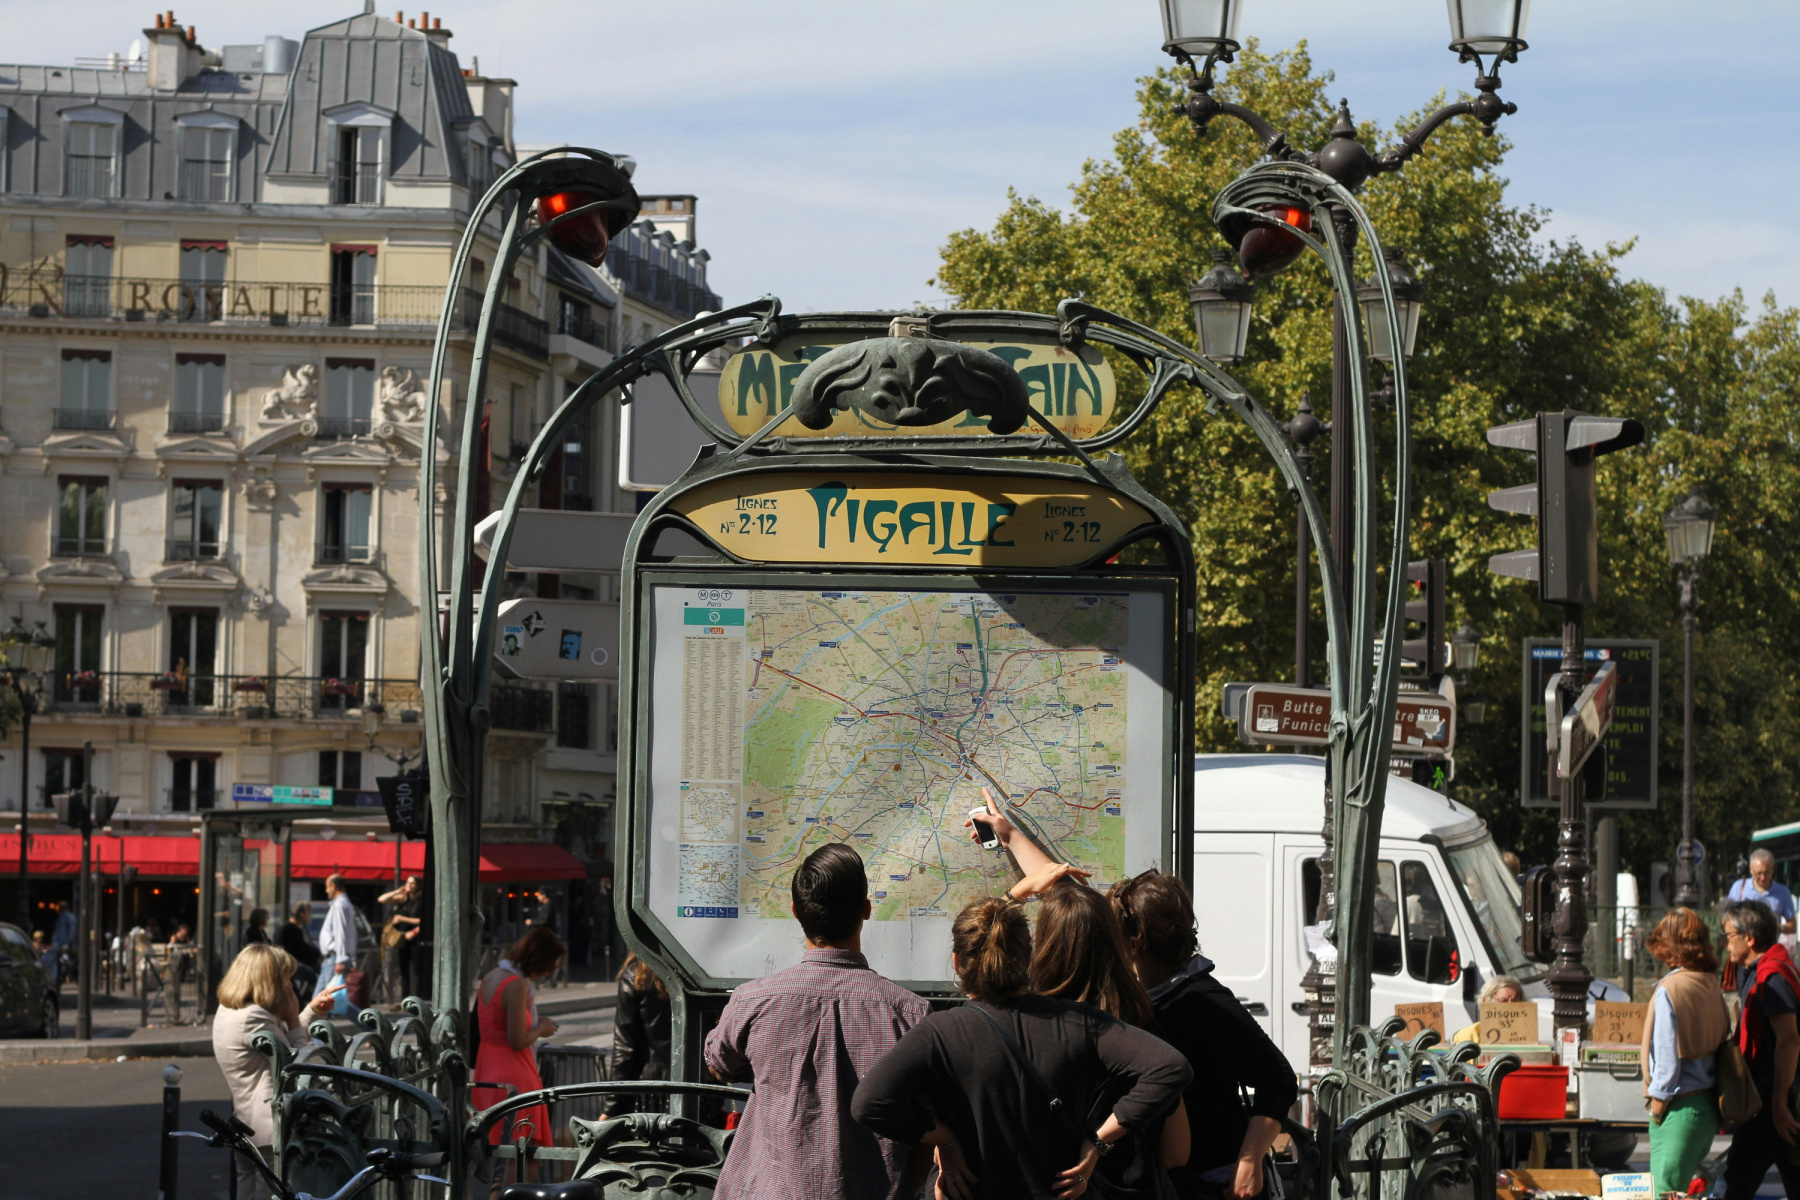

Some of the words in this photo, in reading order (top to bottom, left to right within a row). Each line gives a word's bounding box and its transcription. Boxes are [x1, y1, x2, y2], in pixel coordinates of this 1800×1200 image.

[128, 281, 322, 317] ROYALE
[735, 495, 778, 511] LIGNES
[1044, 502, 1087, 518] LIGNES
[805, 480, 1017, 555] PIGALLE
[1283, 699, 1323, 714] Butte
[1282, 717, 1330, 733] Funicu
